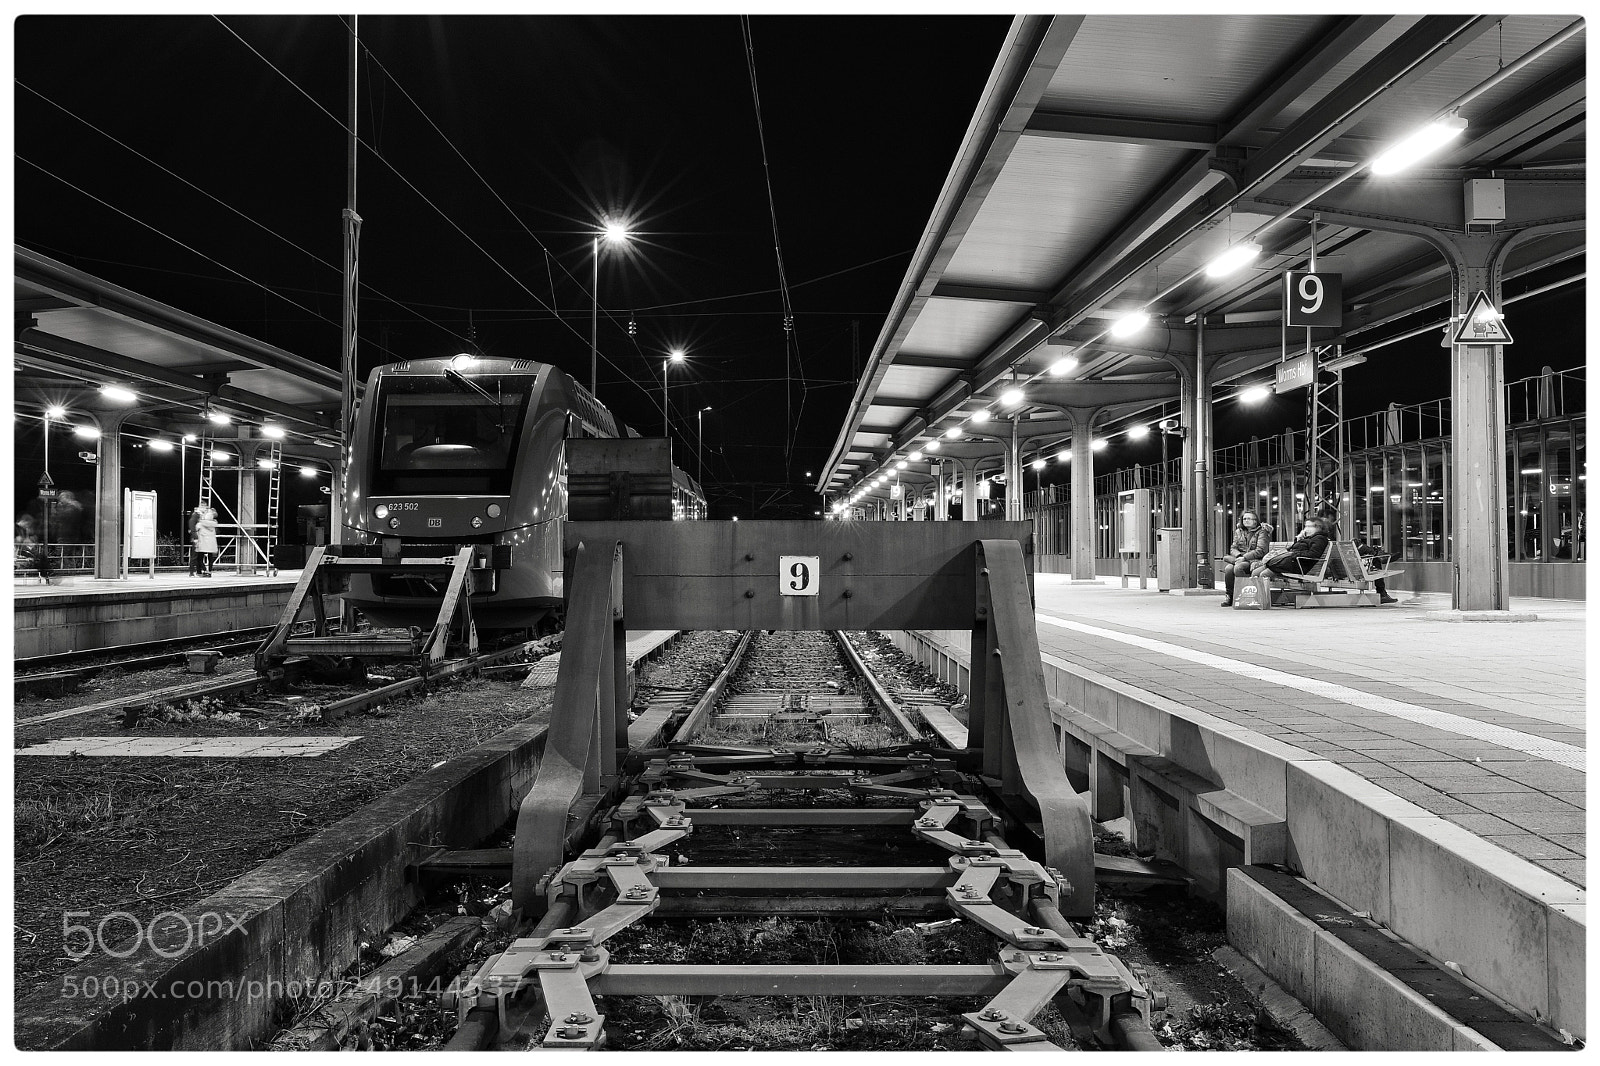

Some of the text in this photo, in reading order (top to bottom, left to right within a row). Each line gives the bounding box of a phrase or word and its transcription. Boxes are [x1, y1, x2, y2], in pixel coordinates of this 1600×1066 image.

[1298, 274, 1324, 314] 9
[1278, 366, 1296, 383] Worms
[892, 487, 901, 497] 9
[388, 502, 419, 511] 623 502
[429, 519, 441, 527] DB
[790, 562, 810, 591] 9
